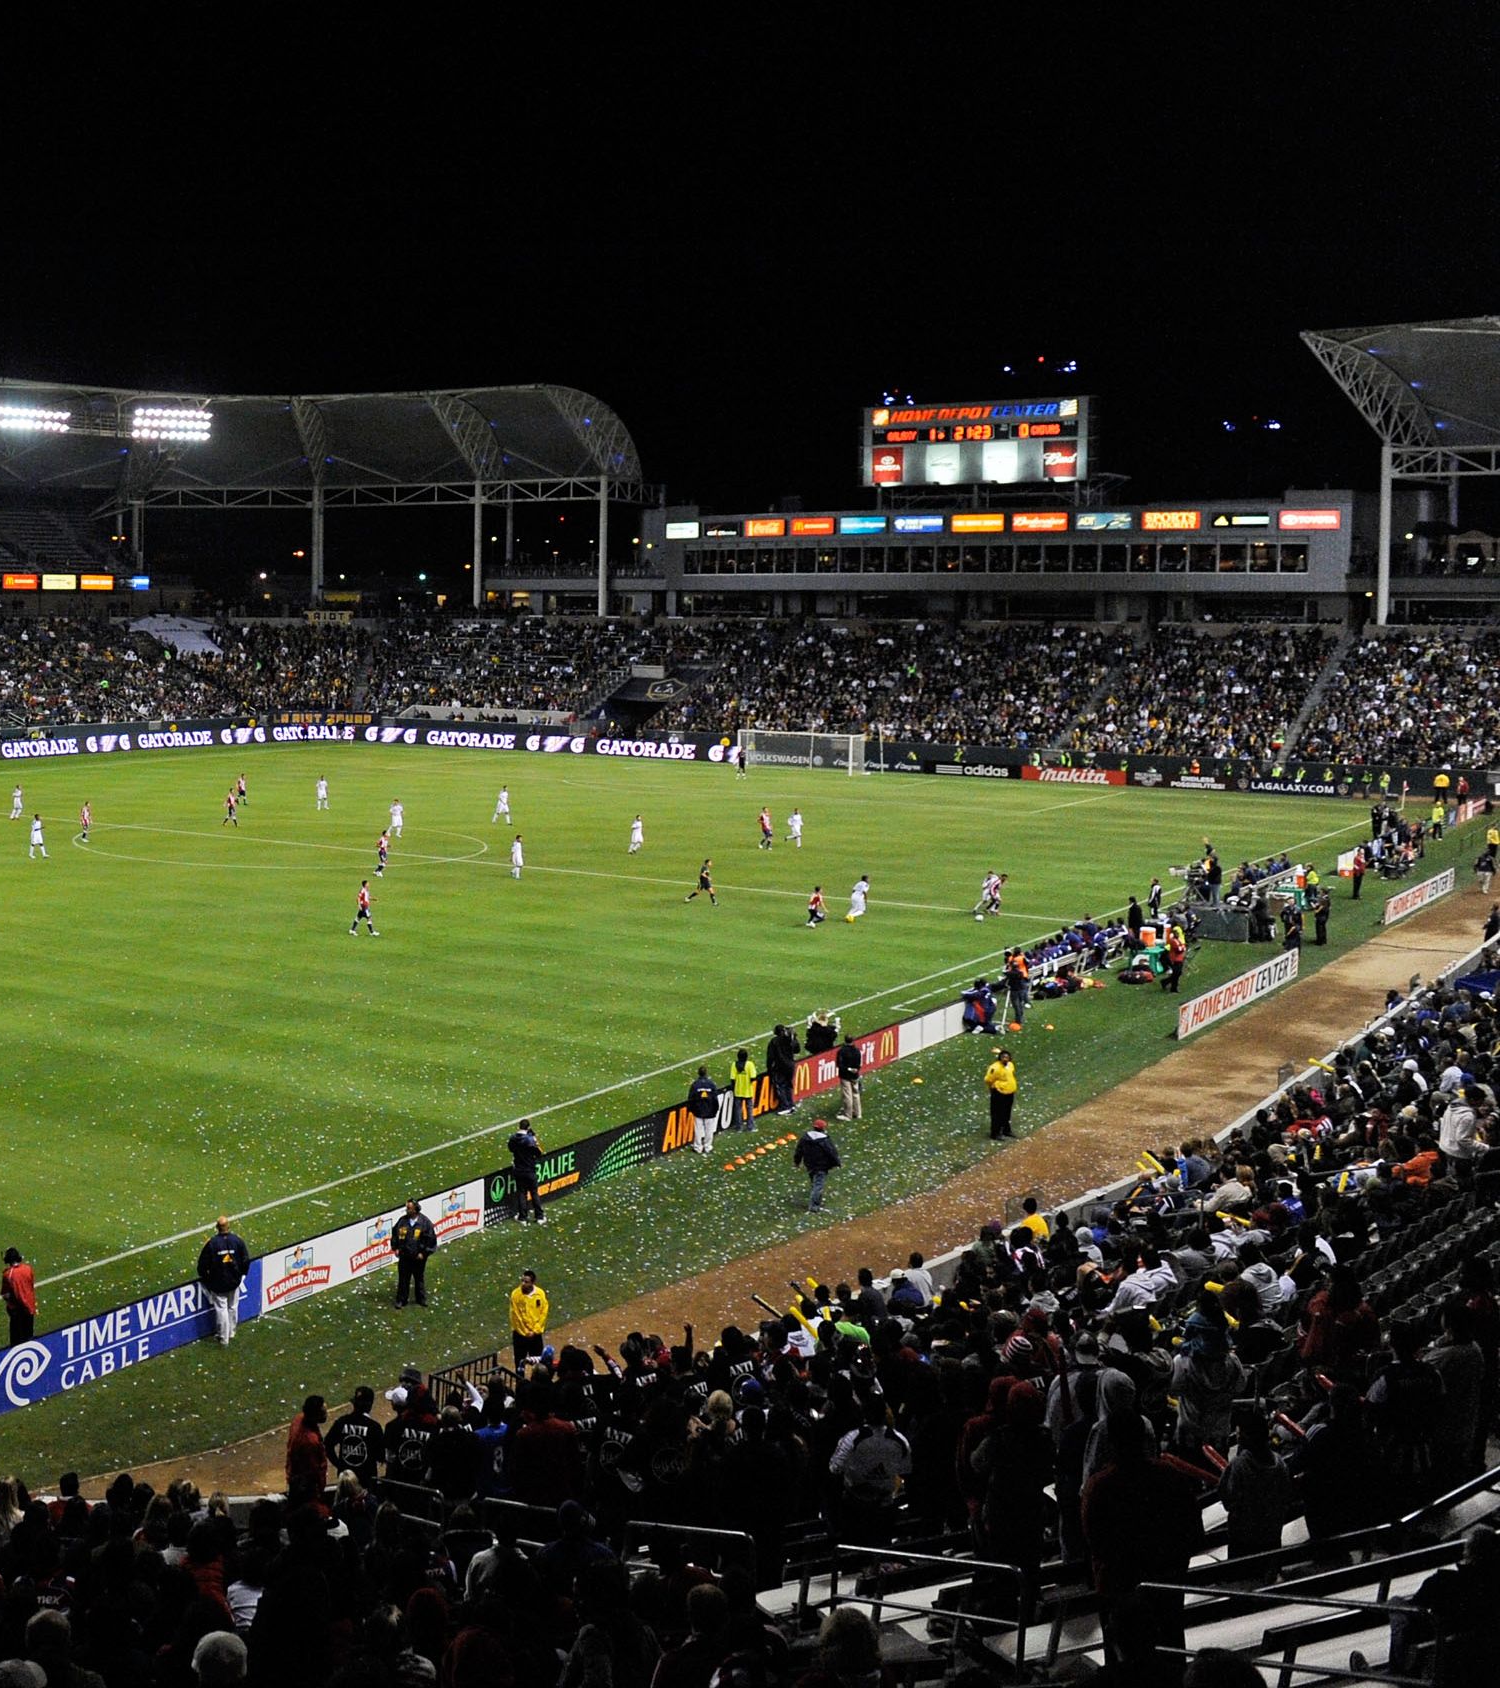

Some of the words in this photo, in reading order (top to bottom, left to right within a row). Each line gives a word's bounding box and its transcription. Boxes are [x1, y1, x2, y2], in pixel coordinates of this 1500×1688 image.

[891, 408, 937, 423] HOME
[1145, 512, 1197, 523] SPORTS
[138, 731, 213, 749] GATORADE
[427, 730, 515, 749] GATORADE
[1, 738, 78, 758] GATORADE
[596, 738, 696, 760] GATORADE
[750, 753, 810, 765] VOLKSWAGEN
[899, 762, 921, 772] Degree
[964, 764, 1009, 778] adidas
[1039, 768, 1109, 785] makita
[1170, 781, 1226, 790] POSSIBILITIES!
[1251, 781, 1334, 794] LAGALAXY.COM
[1190, 990, 1223, 1028] HOME
[1222, 973, 1257, 1010] DEPOT
[1255, 957, 1289, 993] CENTER
[457, 1211, 479, 1224] JOHN
[352, 1245, 384, 1270] FARMER
[270, 1274, 304, 1301] FARMER
[303, 1269, 329, 1285] JOHN
[61, 1308, 131, 1359] TIME
[61, 1337, 150, 1391] CABLE
[729, 1360, 754, 1377] ANTI
[635, 1372, 657, 1388] ANTI
[342, 1423, 369, 1437] ANTI
[576, 1417, 598, 1430] NTI
[403, 1427, 431, 1442] ANTI
[605, 1426, 634, 1444] ANTI
